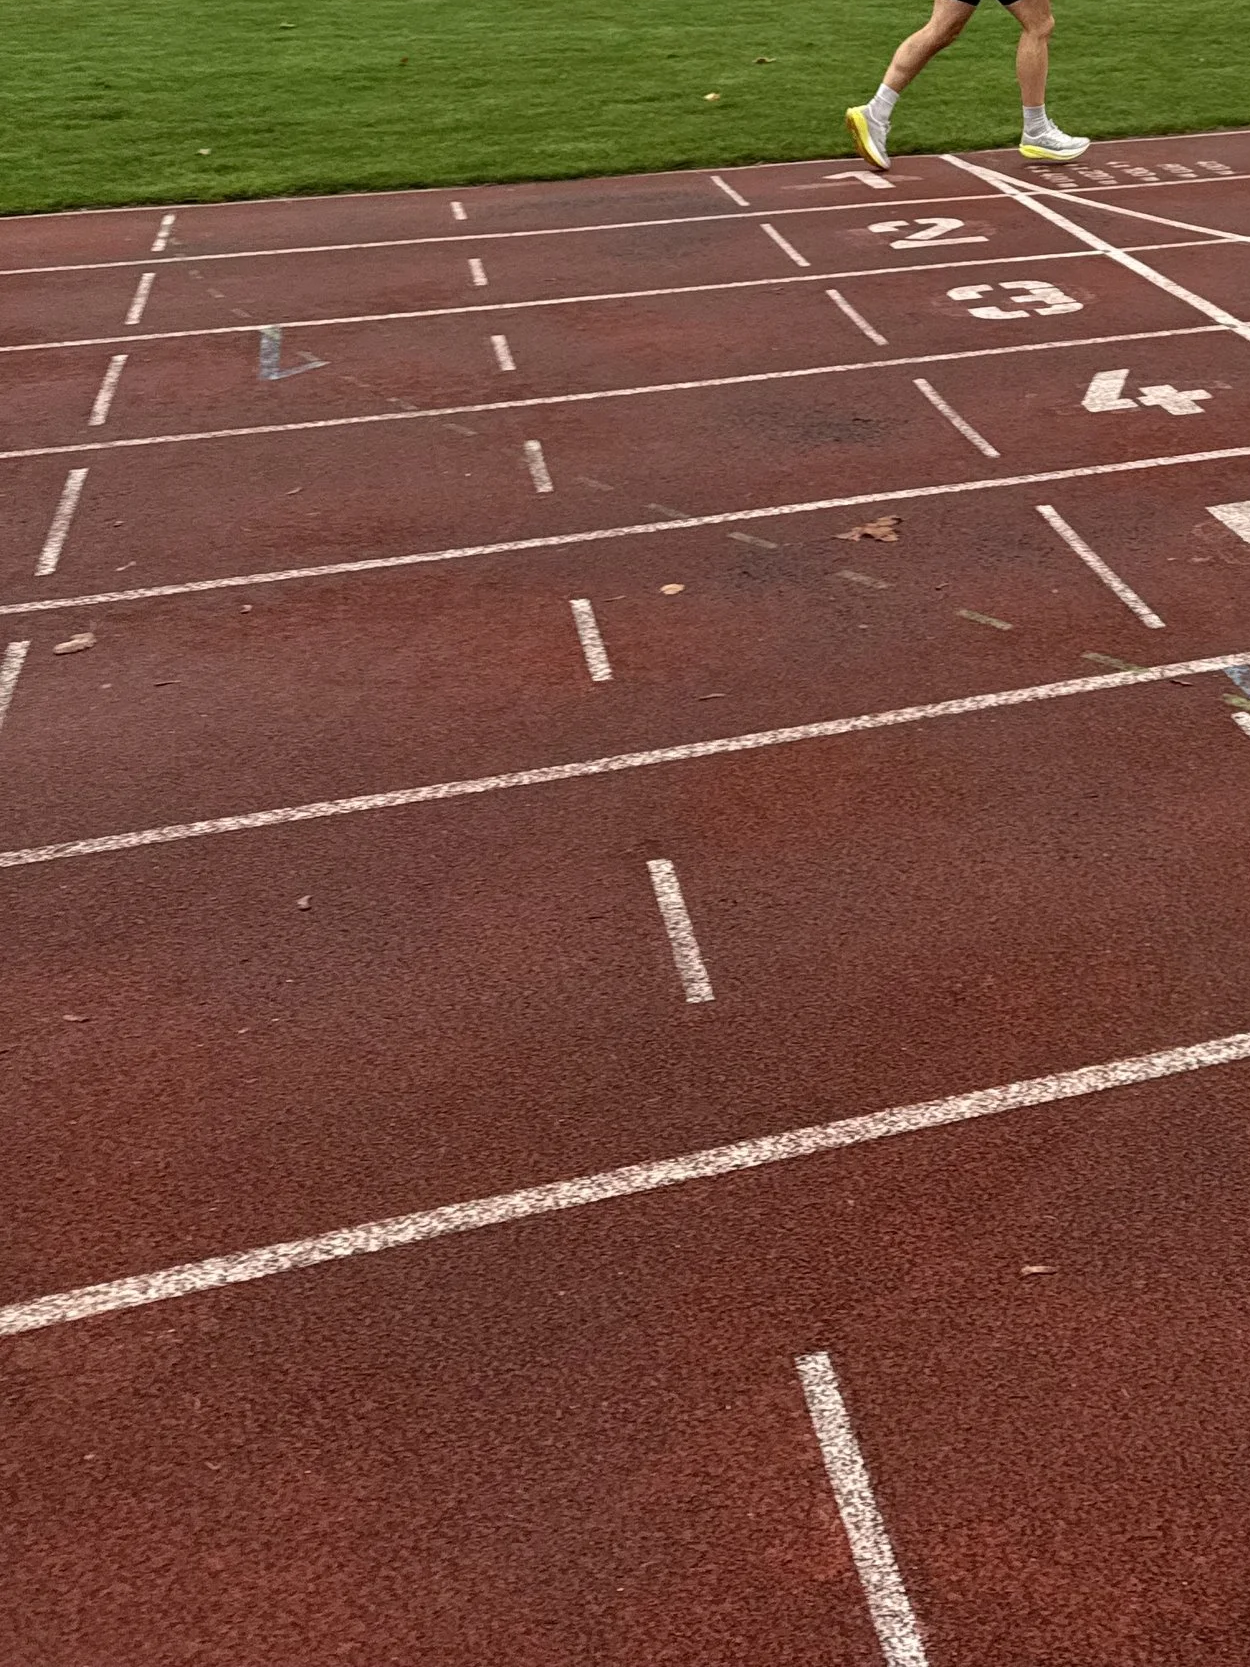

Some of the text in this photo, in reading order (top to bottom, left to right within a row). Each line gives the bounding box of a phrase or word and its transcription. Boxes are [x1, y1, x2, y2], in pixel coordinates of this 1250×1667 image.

[824, 170, 896, 189] 1
[867, 217, 990, 249] 2
[946, 280, 1084, 320] 3
[1081, 368, 1213, 416] 4
